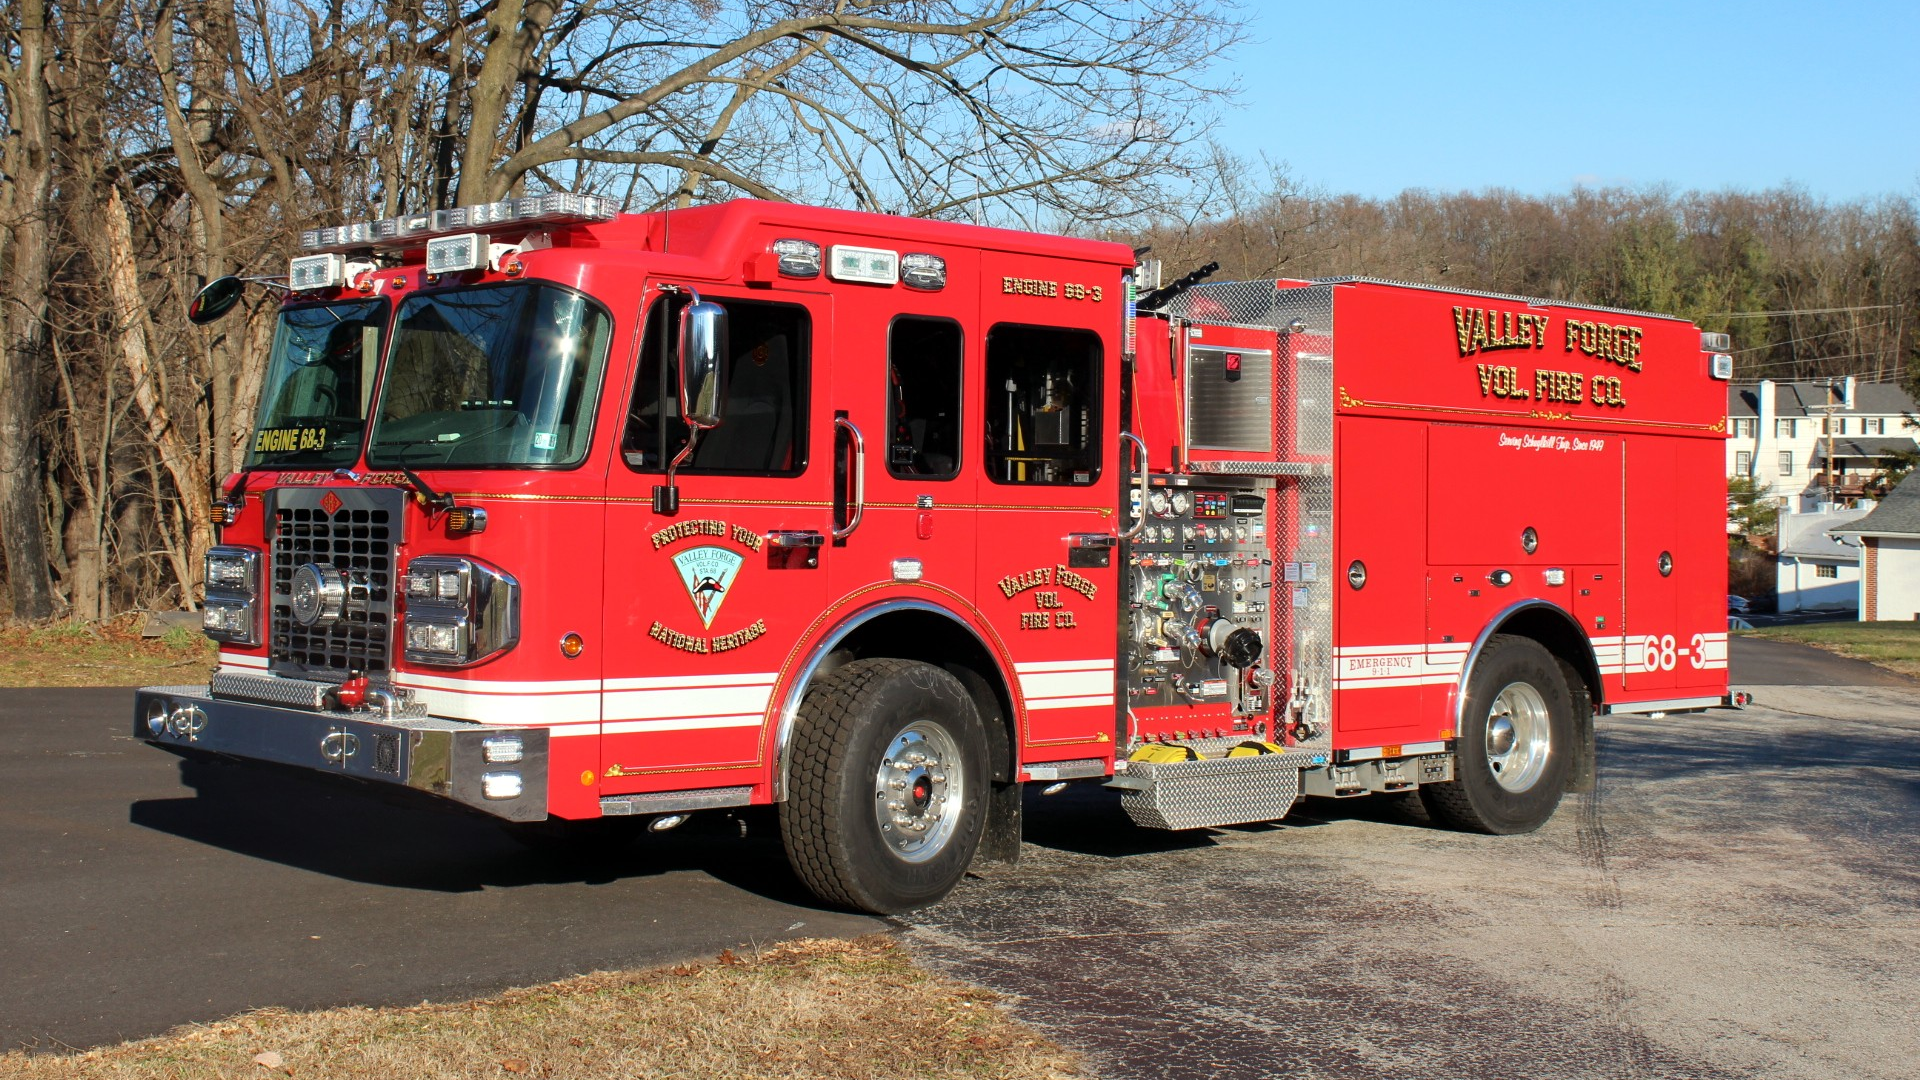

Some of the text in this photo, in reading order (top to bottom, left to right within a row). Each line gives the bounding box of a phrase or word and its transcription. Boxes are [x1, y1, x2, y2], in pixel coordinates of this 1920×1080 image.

[1002, 276, 1102, 302] ENGINE 68-3
[1452, 305, 1643, 372] VALLEY FORGE
[1476, 363, 1626, 407] VOL. FIRE CO.
[255, 427, 326, 452] ENGINE 68-3
[1589, 439, 1604, 451] 1949
[276, 472, 332, 485] VALLEY
[651, 519, 764, 553] PROTECTING YOUR
[678, 549, 737, 565] VALLEY FORGE
[1035, 591, 1063, 609] VOL.
[1021, 611, 1077, 629] FIRE CO.
[649, 618, 767, 654] NATIONAL HERITAGE
[1349, 656, 1413, 671] EMERGENCY
[1643, 633, 1706, 672] 68-3
